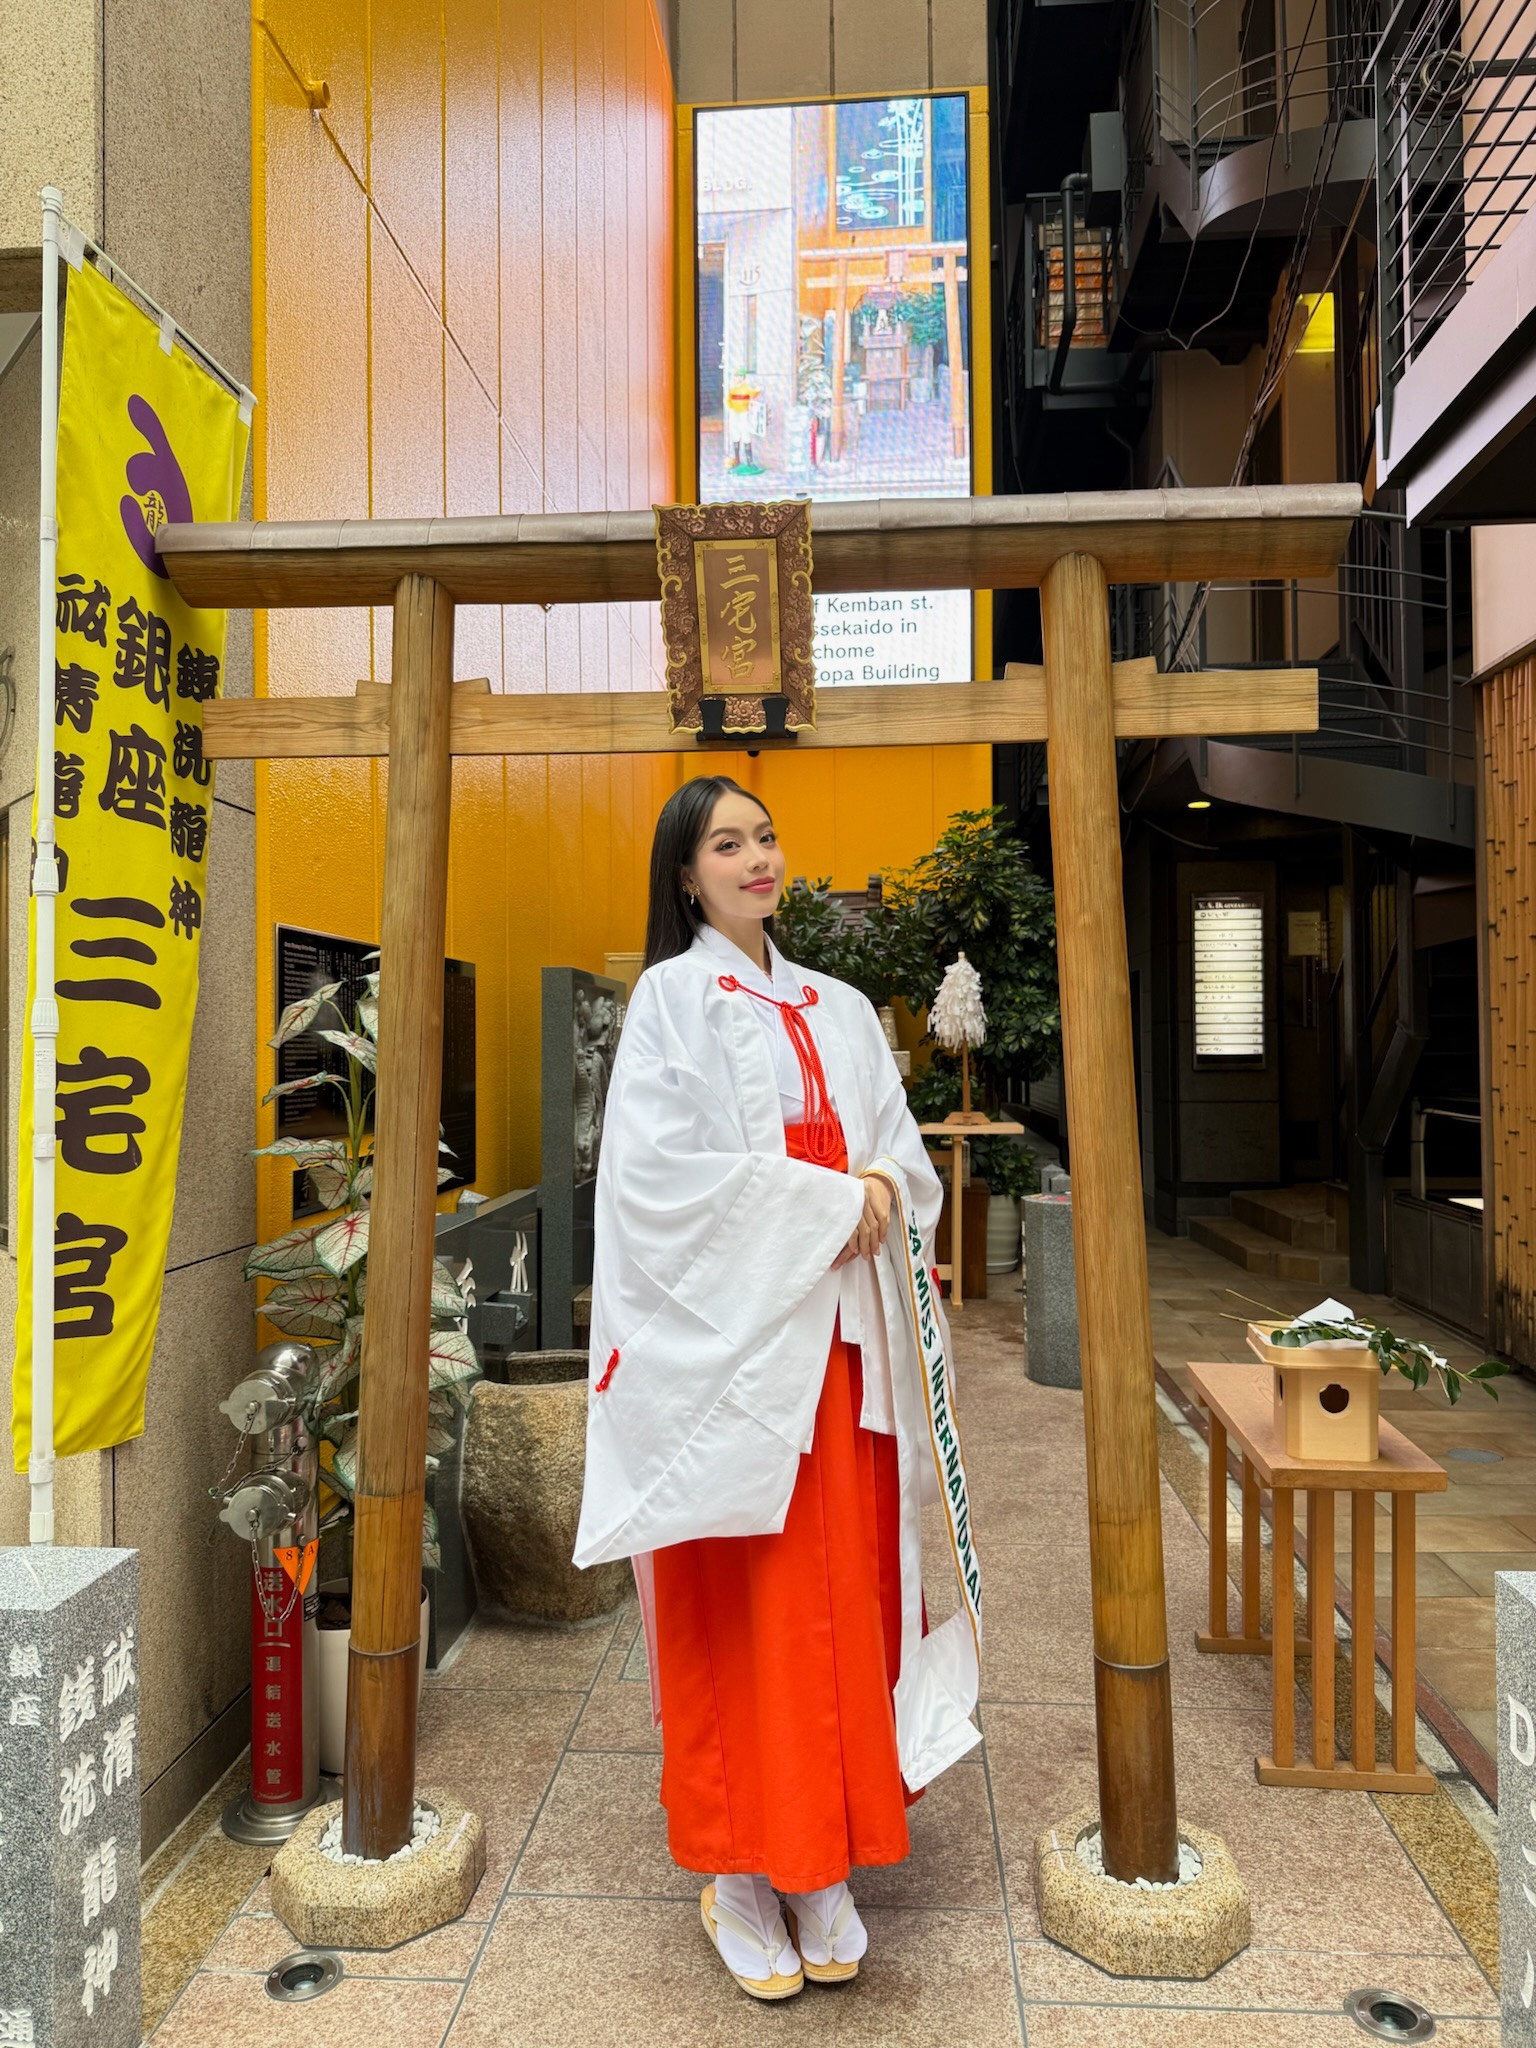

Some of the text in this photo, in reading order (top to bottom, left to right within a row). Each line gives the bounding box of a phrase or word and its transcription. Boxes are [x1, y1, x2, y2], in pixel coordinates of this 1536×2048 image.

[720, 554, 760, 679] 三宅宮
[828, 597, 903, 613] Kemban
[910, 595, 934, 610] st.
[901, 618, 917, 633] in
[813, 644, 875, 659] chome
[863, 664, 940, 682] Building
[54, 596, 172, 1339] 銀座三宅宮
[915, 1267, 937, 1350] MISS
[931, 1353, 982, 1616] INTERNATIONAL
[263, 1571, 284, 1637] 送水口
[265, 1656, 282, 1785] 連結送水管
